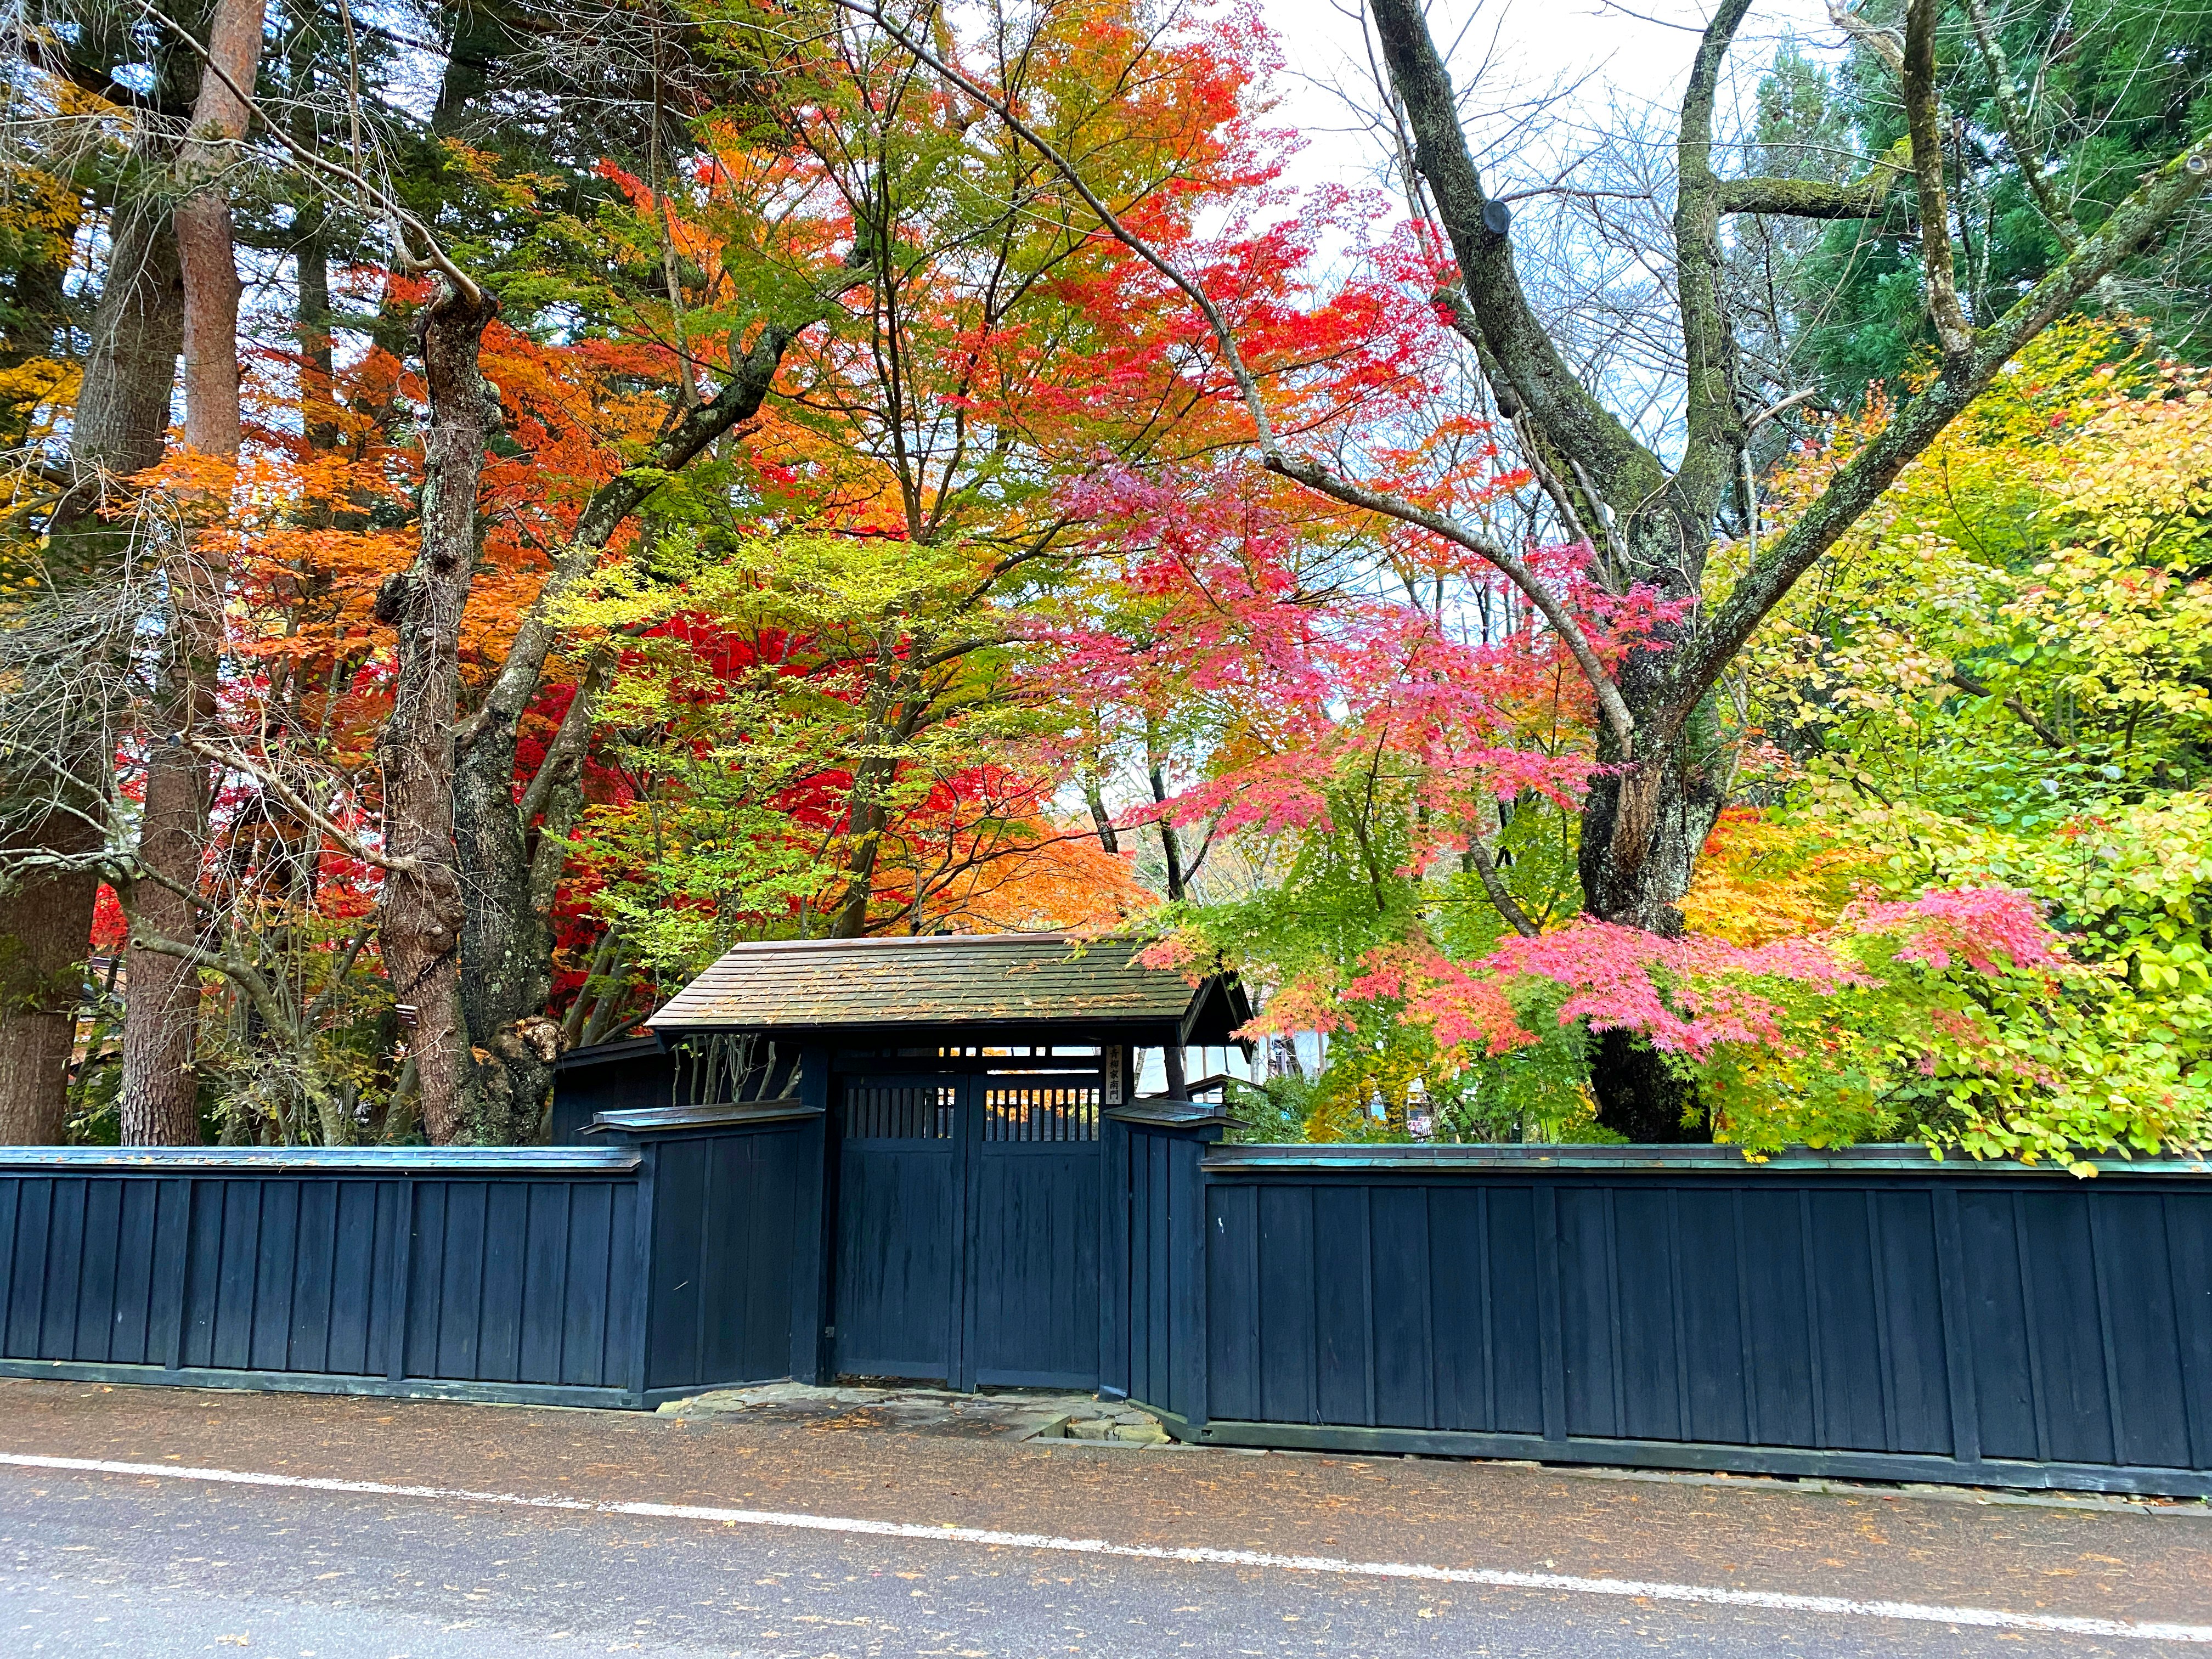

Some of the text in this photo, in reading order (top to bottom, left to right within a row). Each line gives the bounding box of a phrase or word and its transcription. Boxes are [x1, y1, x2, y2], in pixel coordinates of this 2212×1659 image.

[1110, 1048, 1119, 1100] 青柳家南門
